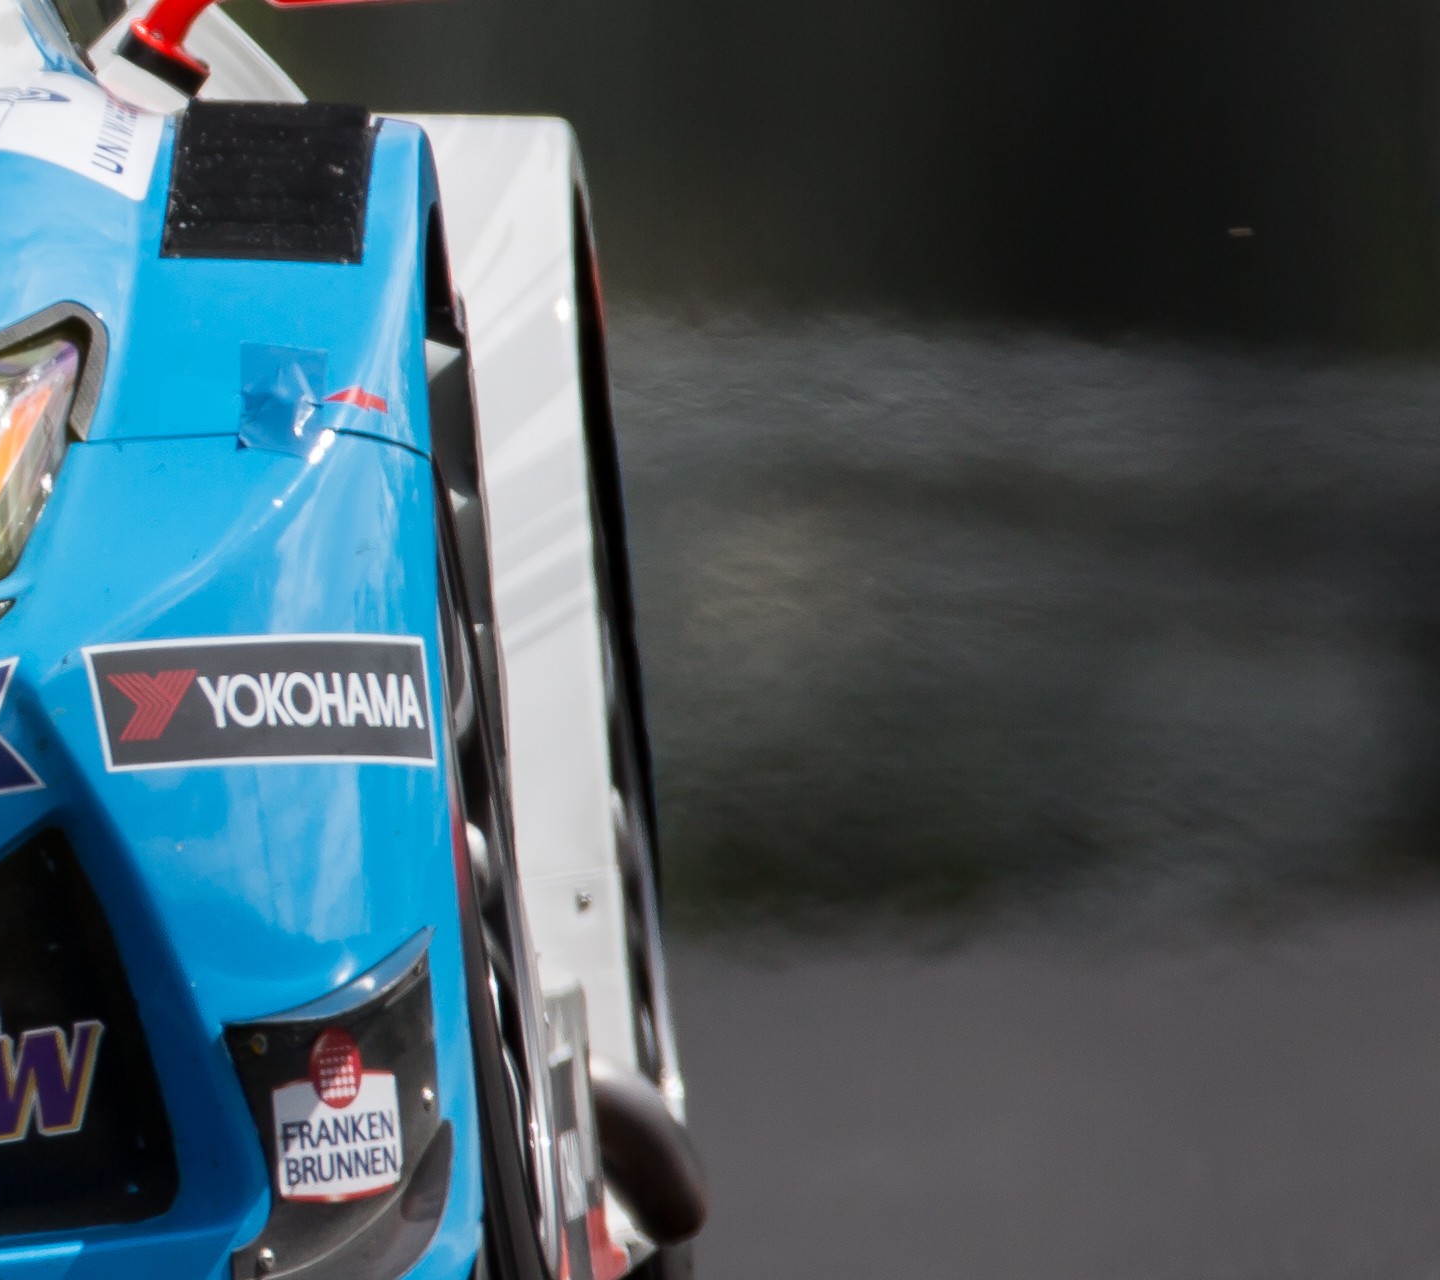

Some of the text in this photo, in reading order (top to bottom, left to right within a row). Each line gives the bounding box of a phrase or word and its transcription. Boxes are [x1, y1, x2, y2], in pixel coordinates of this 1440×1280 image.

[196, 669, 426, 729] YOKOHAMA
[281, 1110, 396, 1153] FRANKEN
[284, 1144, 399, 1187] BRUNNEN
